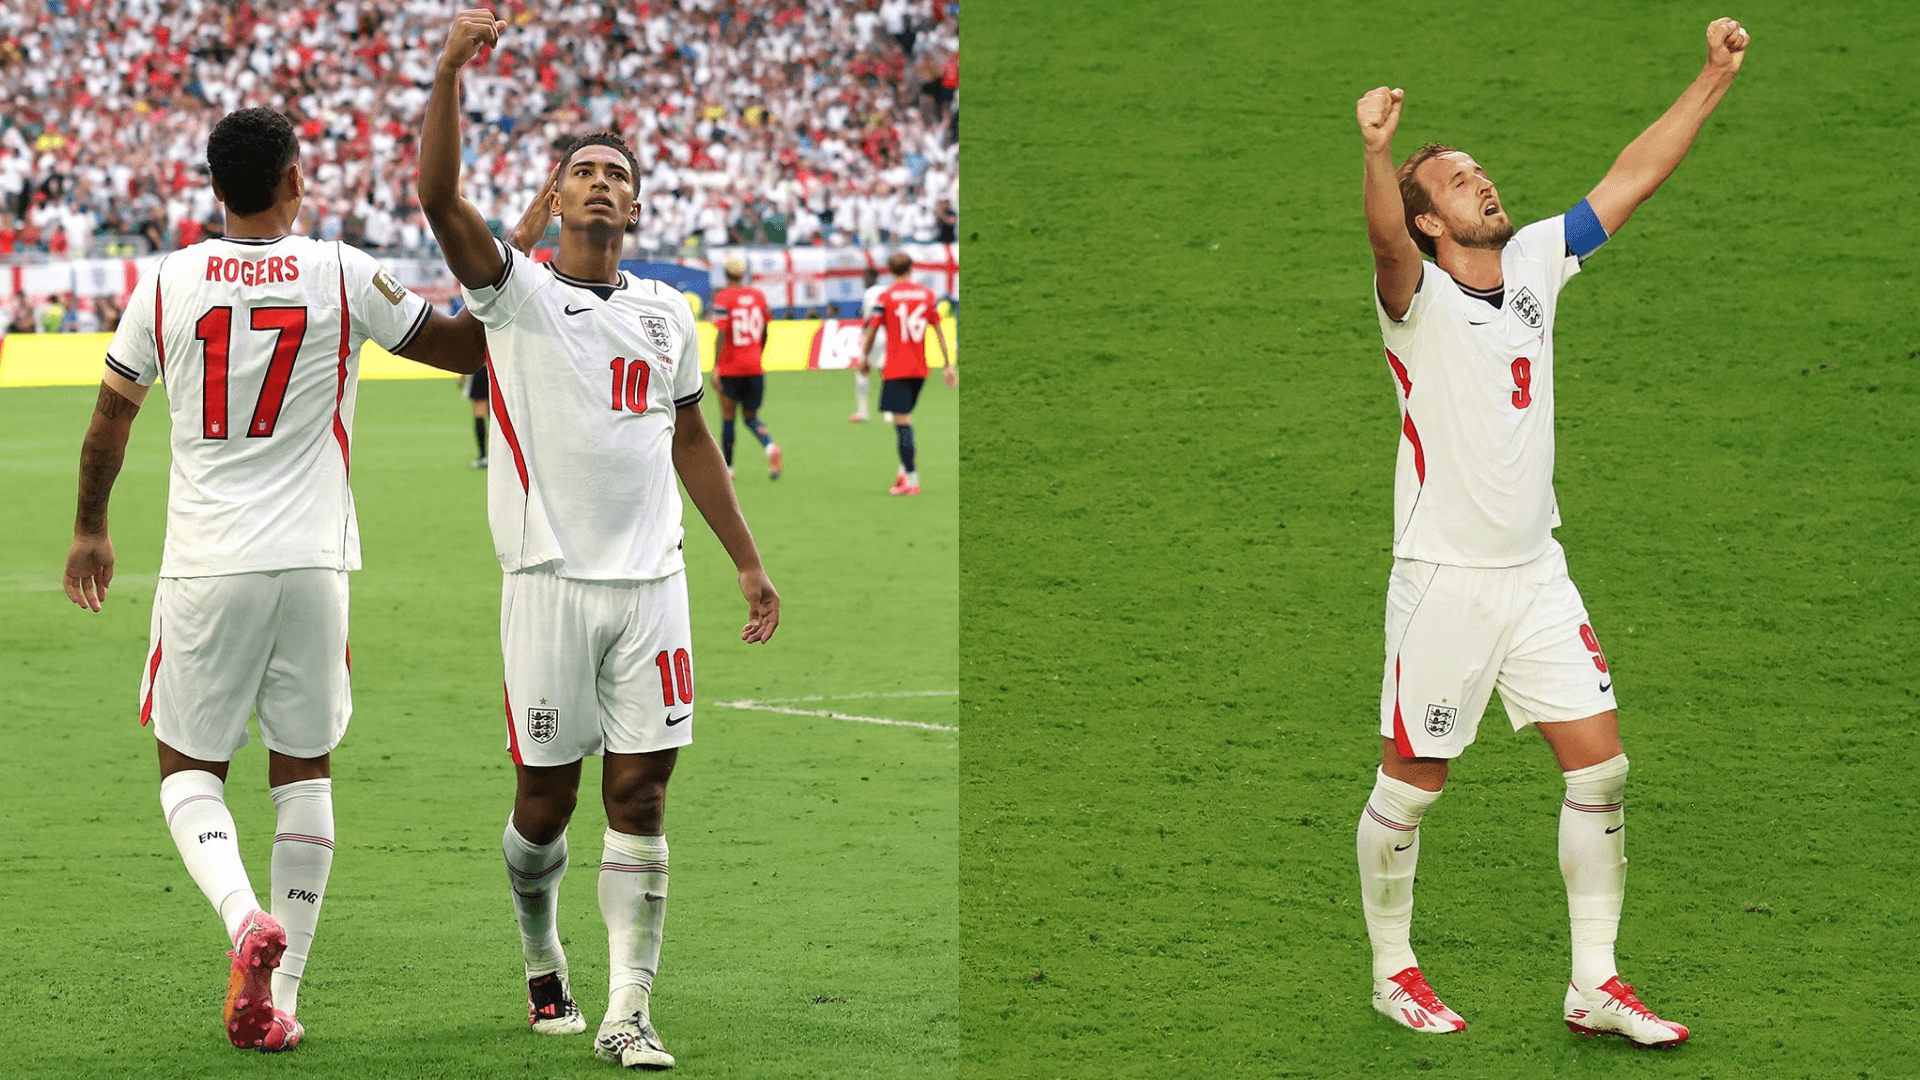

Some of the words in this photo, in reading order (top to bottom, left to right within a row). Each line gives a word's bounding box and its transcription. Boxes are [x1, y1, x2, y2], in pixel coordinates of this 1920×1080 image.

[206, 255, 300, 287] ROGERS
[895, 302, 928, 343] 16
[195, 305, 308, 440] 17
[609, 356, 651, 415] 10
[1511, 357, 1532, 410] 9
[1579, 623, 1608, 673] 9
[655, 647, 694, 707] 10
[198, 830, 229, 844] ENG
[287, 888, 319, 905] ENG
